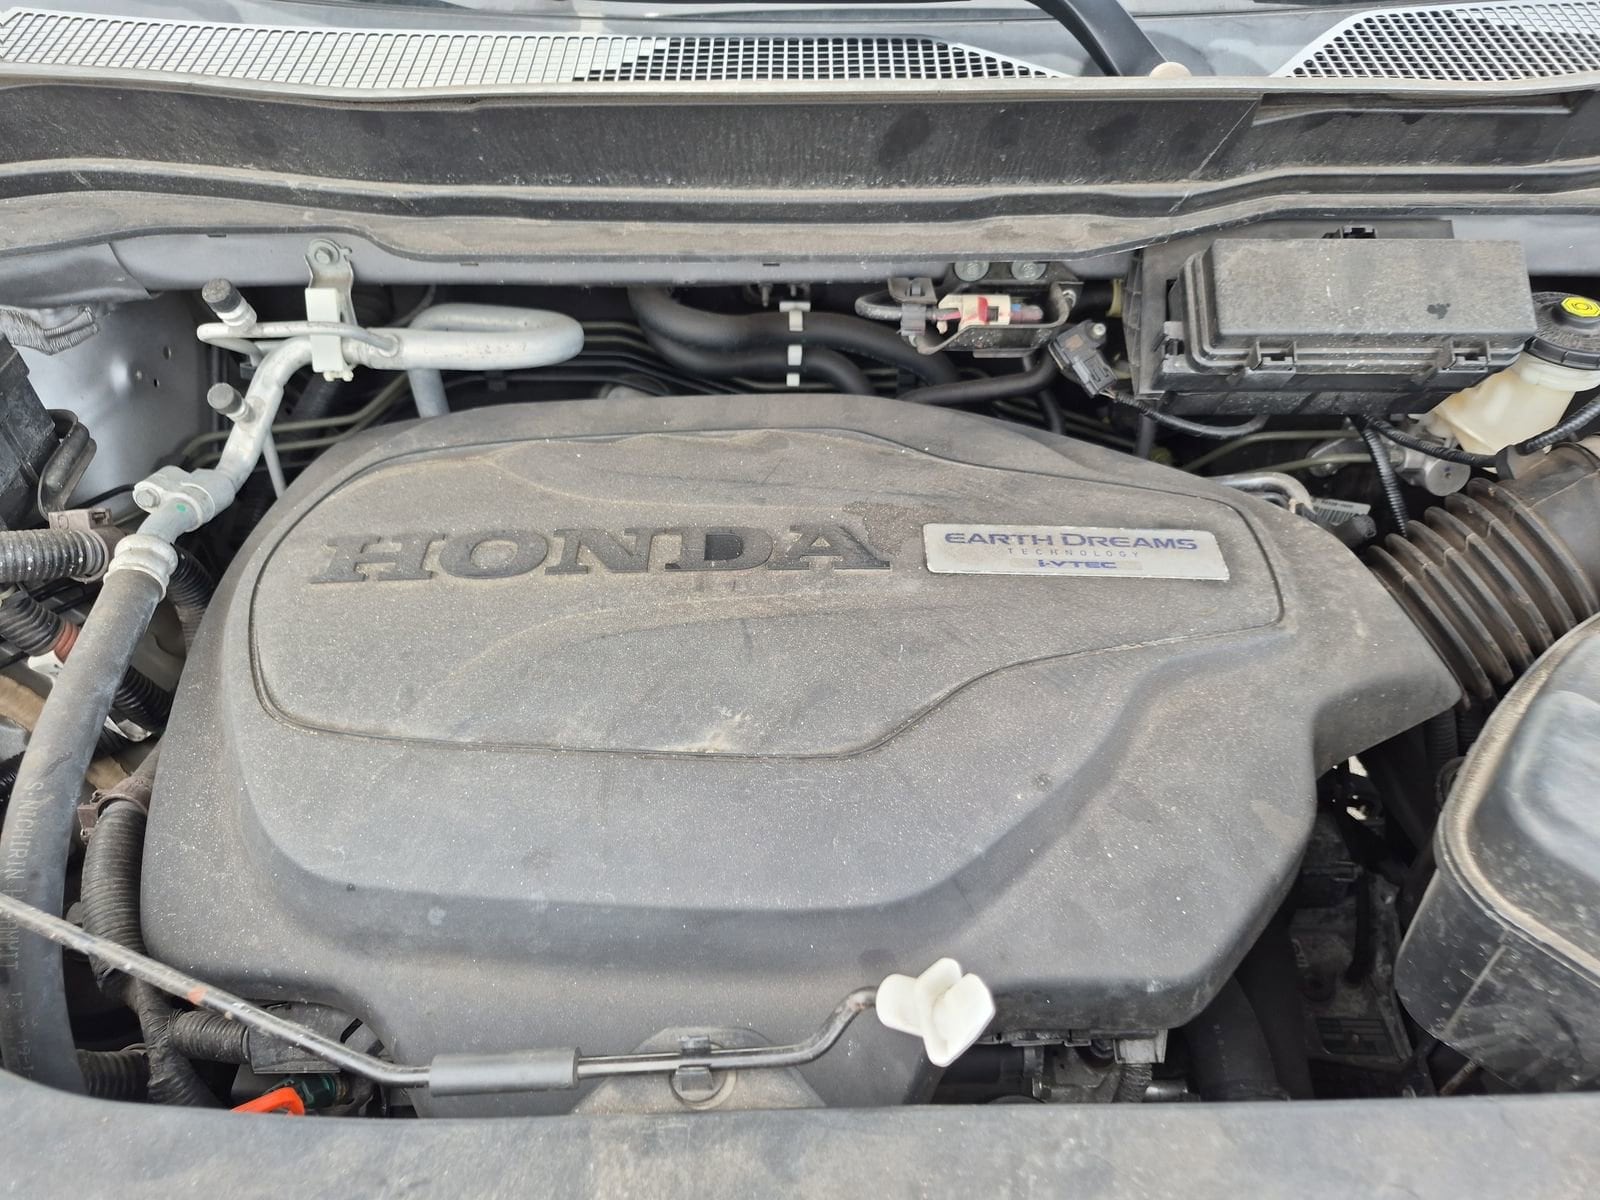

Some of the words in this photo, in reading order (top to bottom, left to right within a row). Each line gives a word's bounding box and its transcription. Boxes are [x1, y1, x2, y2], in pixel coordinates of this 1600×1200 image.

[944, 532, 1054, 546] EARTH
[1060, 533, 1198, 550] DREAMS
[309, 524, 891, 584] HONDA
[1007, 547, 1139, 558] TECHNOLOGY
